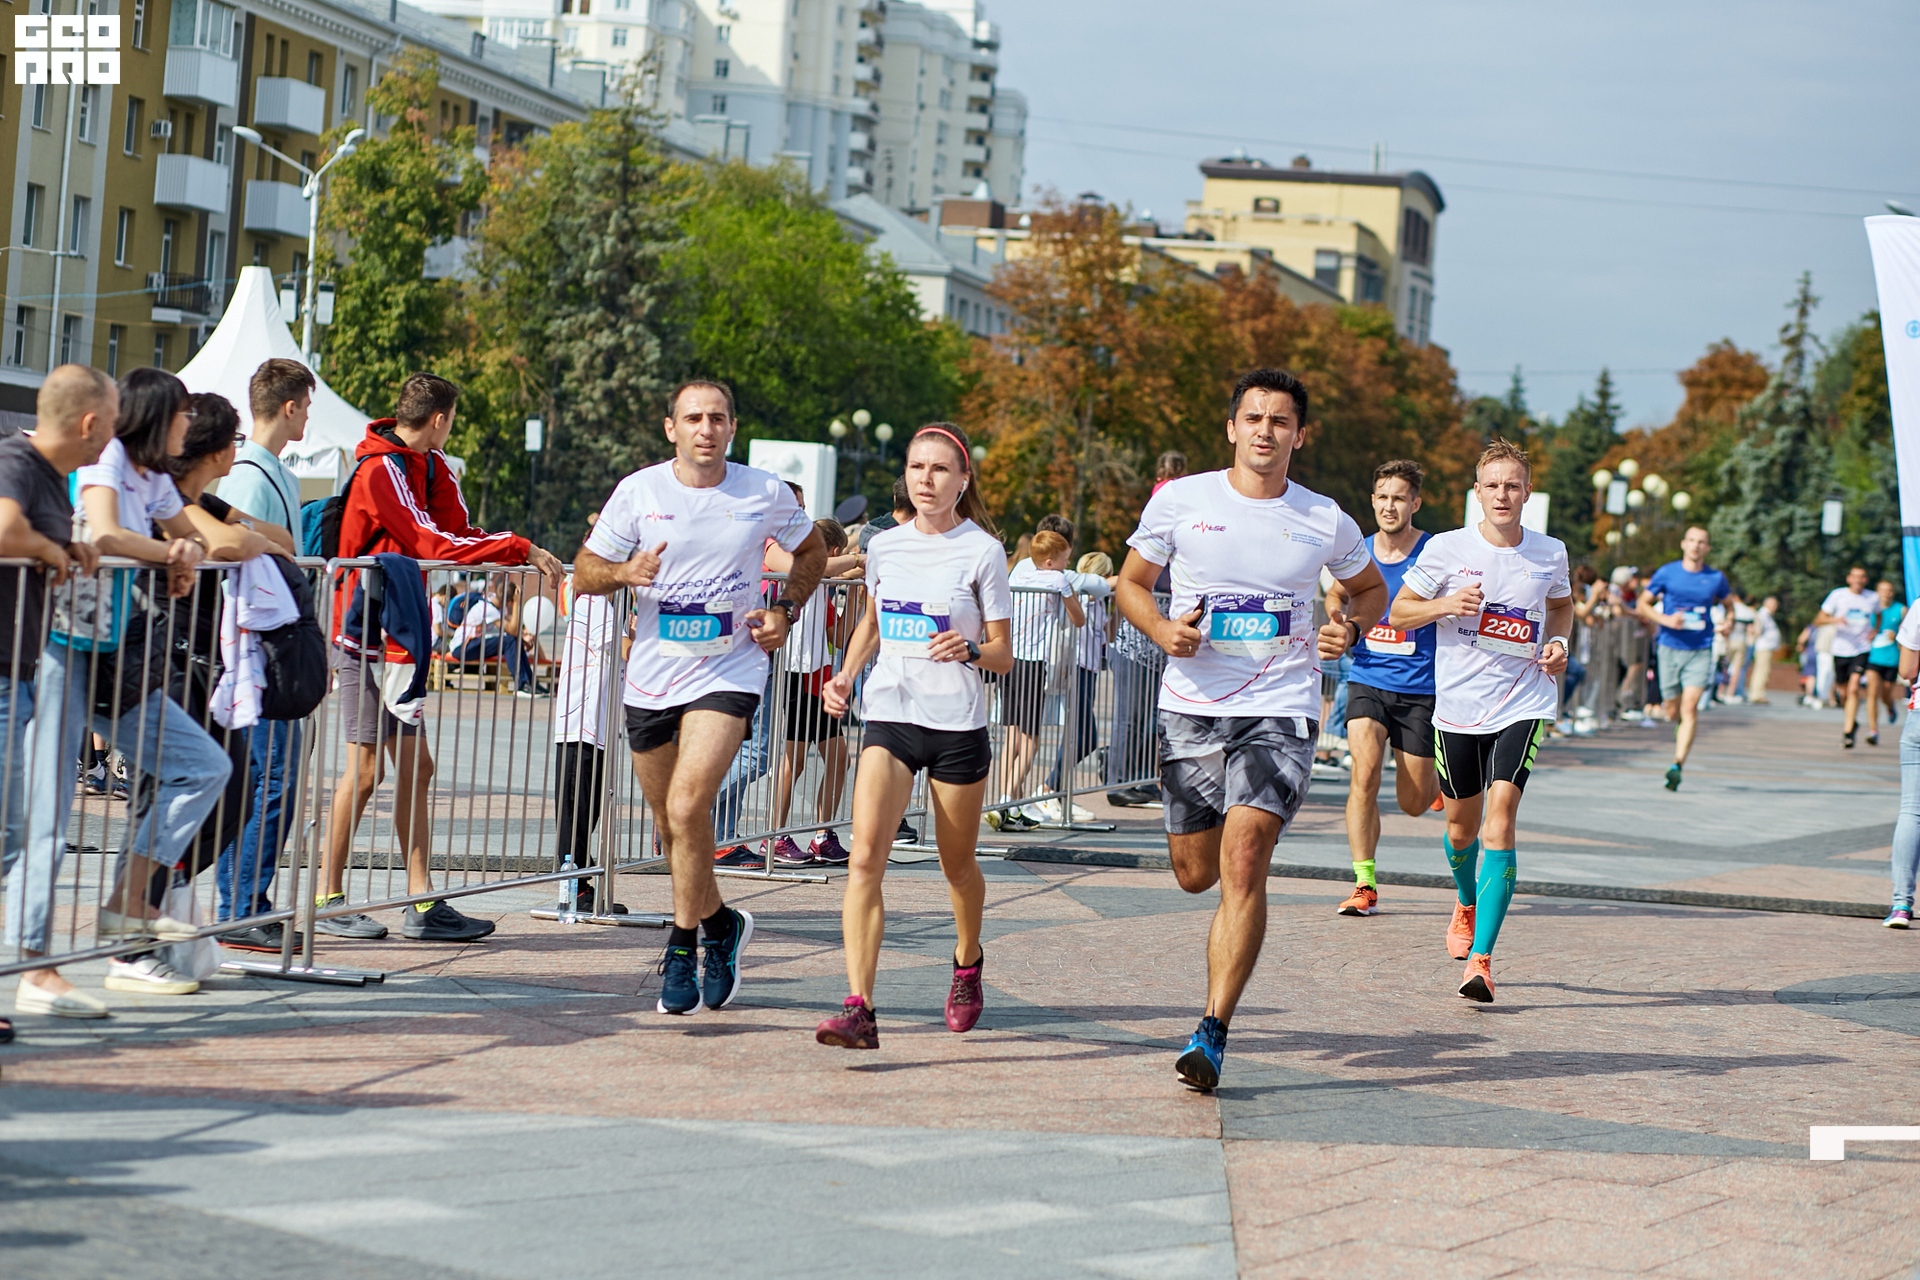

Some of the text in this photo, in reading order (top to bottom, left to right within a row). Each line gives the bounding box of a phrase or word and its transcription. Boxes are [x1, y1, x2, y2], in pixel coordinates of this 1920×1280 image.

[668, 619, 712, 639] 1081
[888, 617, 927, 639] 1130
[1222, 617, 1272, 637] 1094
[1368, 627, 1397, 641] 2211
[1483, 617, 1531, 641] 2200
